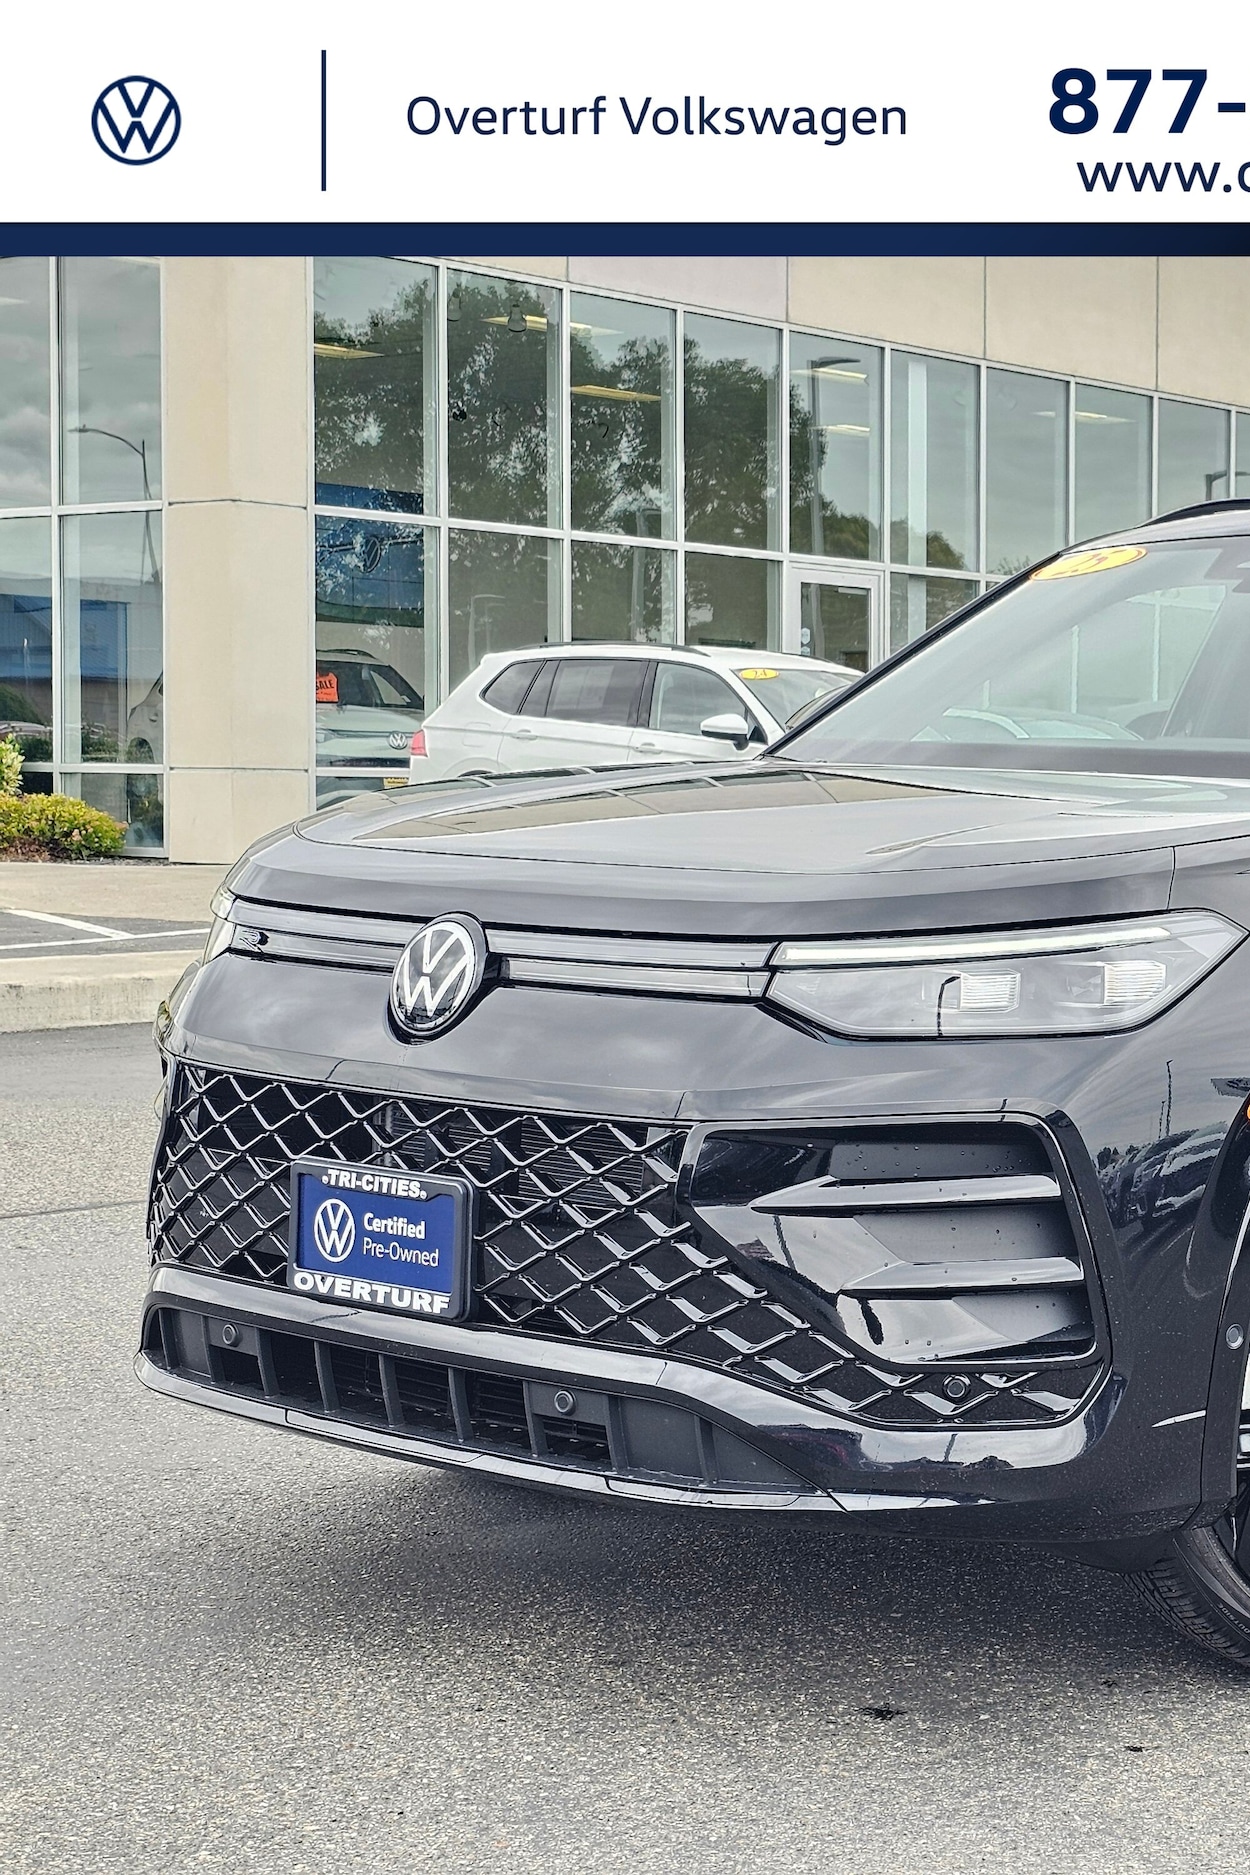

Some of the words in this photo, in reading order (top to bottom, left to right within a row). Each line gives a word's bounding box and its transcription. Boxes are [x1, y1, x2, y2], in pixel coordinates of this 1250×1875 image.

[363, 1211, 426, 1240] Certified
[362, 1236, 439, 1268] Pre-Owned
[293, 1271, 450, 1315] OVERTURF
